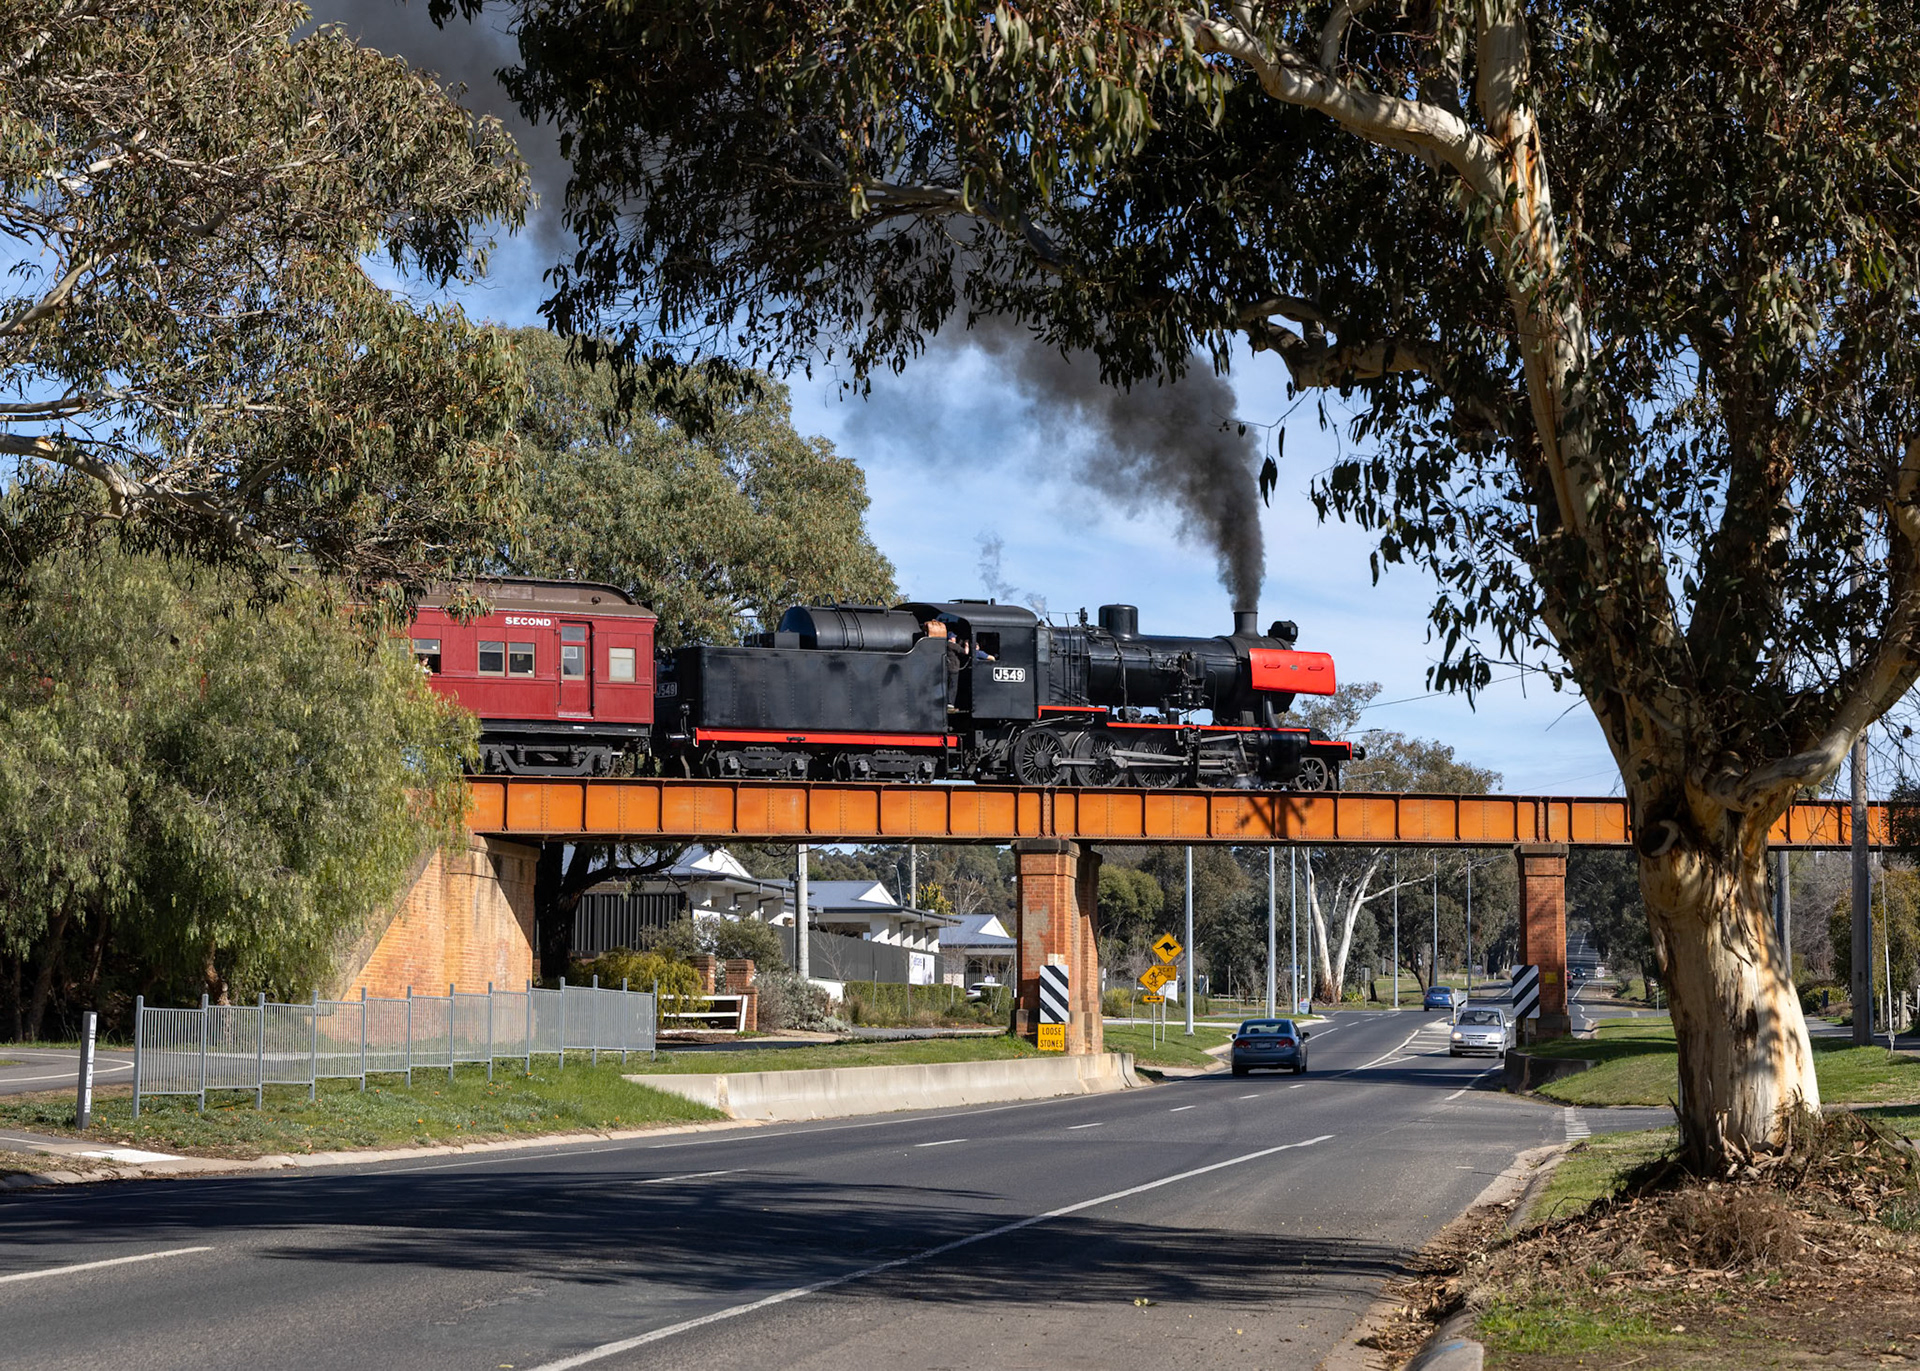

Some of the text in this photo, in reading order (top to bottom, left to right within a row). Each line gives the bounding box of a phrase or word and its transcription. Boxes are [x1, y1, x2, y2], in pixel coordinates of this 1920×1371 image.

[504, 616, 552, 627] SECOND
[995, 669, 1024, 681] J549
[657, 684, 675, 696] J549
[1041, 1027, 1062, 1035] LOOSE
[1040, 1040, 1063, 1048] STONES
